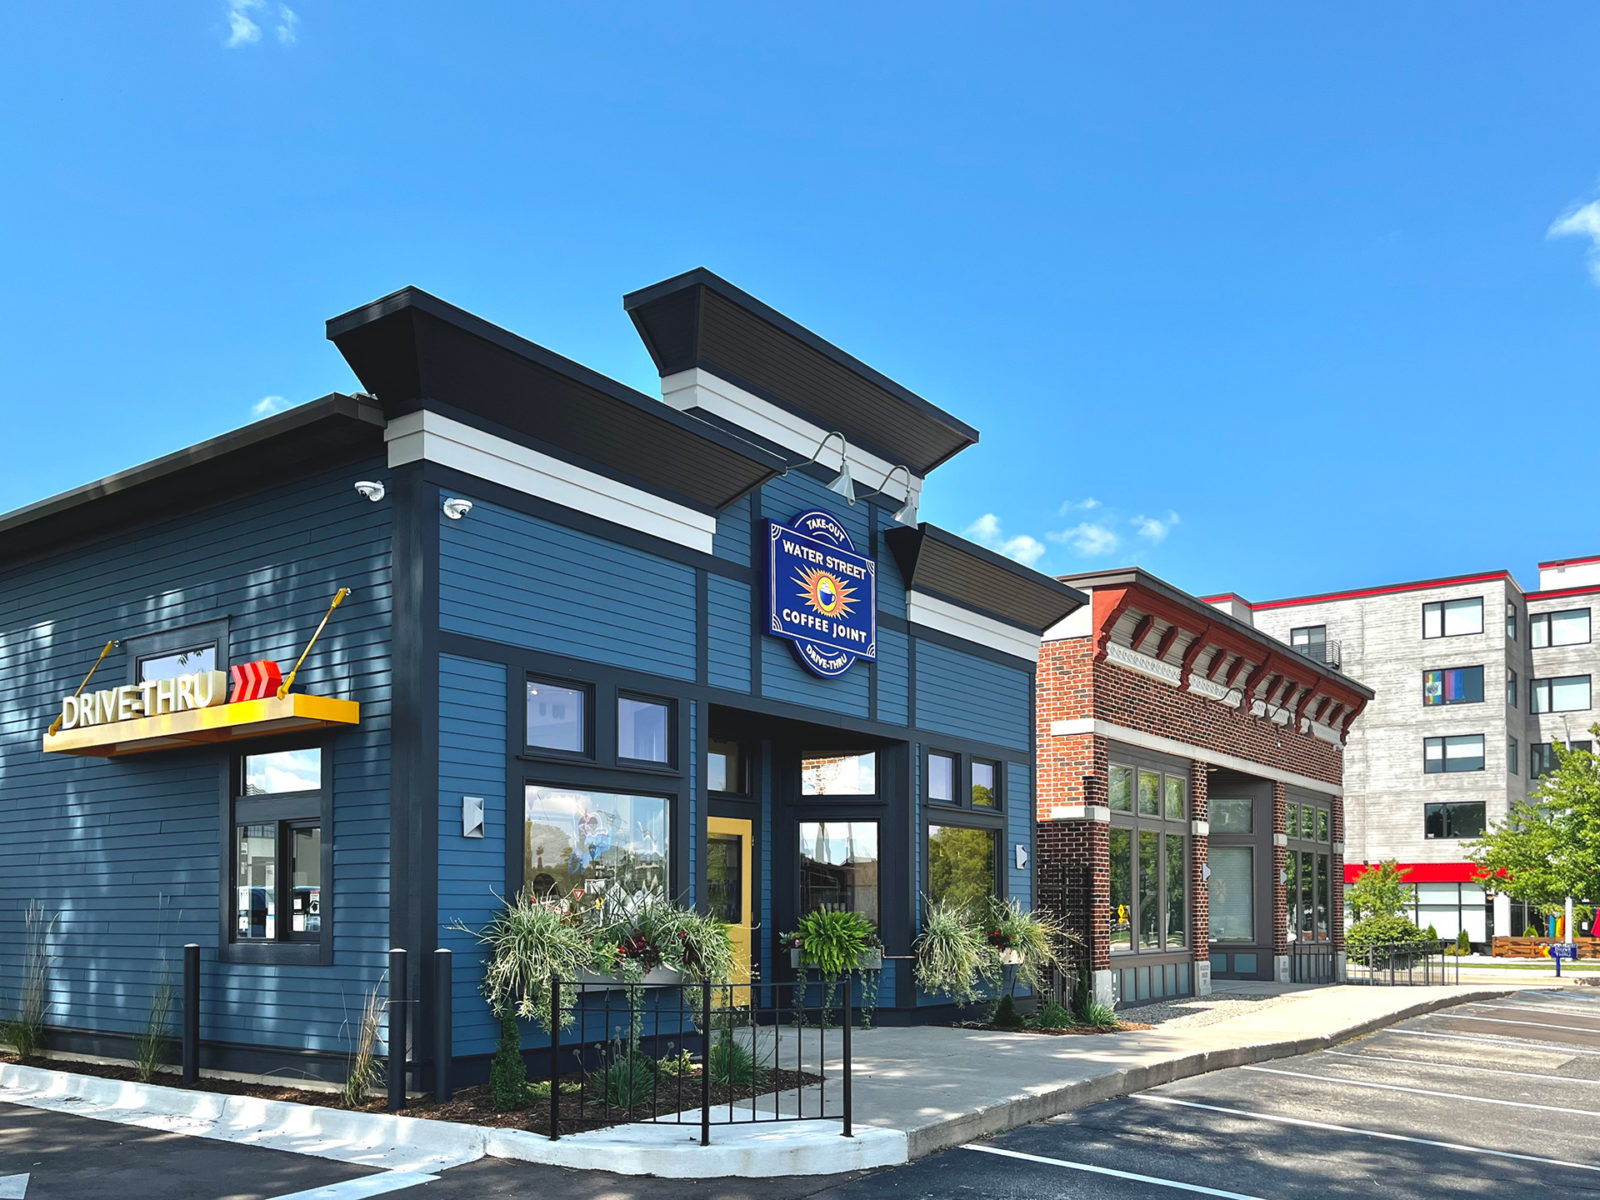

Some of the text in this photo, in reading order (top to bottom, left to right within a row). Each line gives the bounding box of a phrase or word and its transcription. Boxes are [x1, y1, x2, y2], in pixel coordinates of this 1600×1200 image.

[806, 518, 845, 542] TAKE-OUT
[783, 540, 866, 580] WATER STREET
[782, 609, 866, 643] COFFEE JOINT
[805, 644, 846, 669] DRIVE-THRU
[62, 670, 225, 729] DRIVE-THRU
